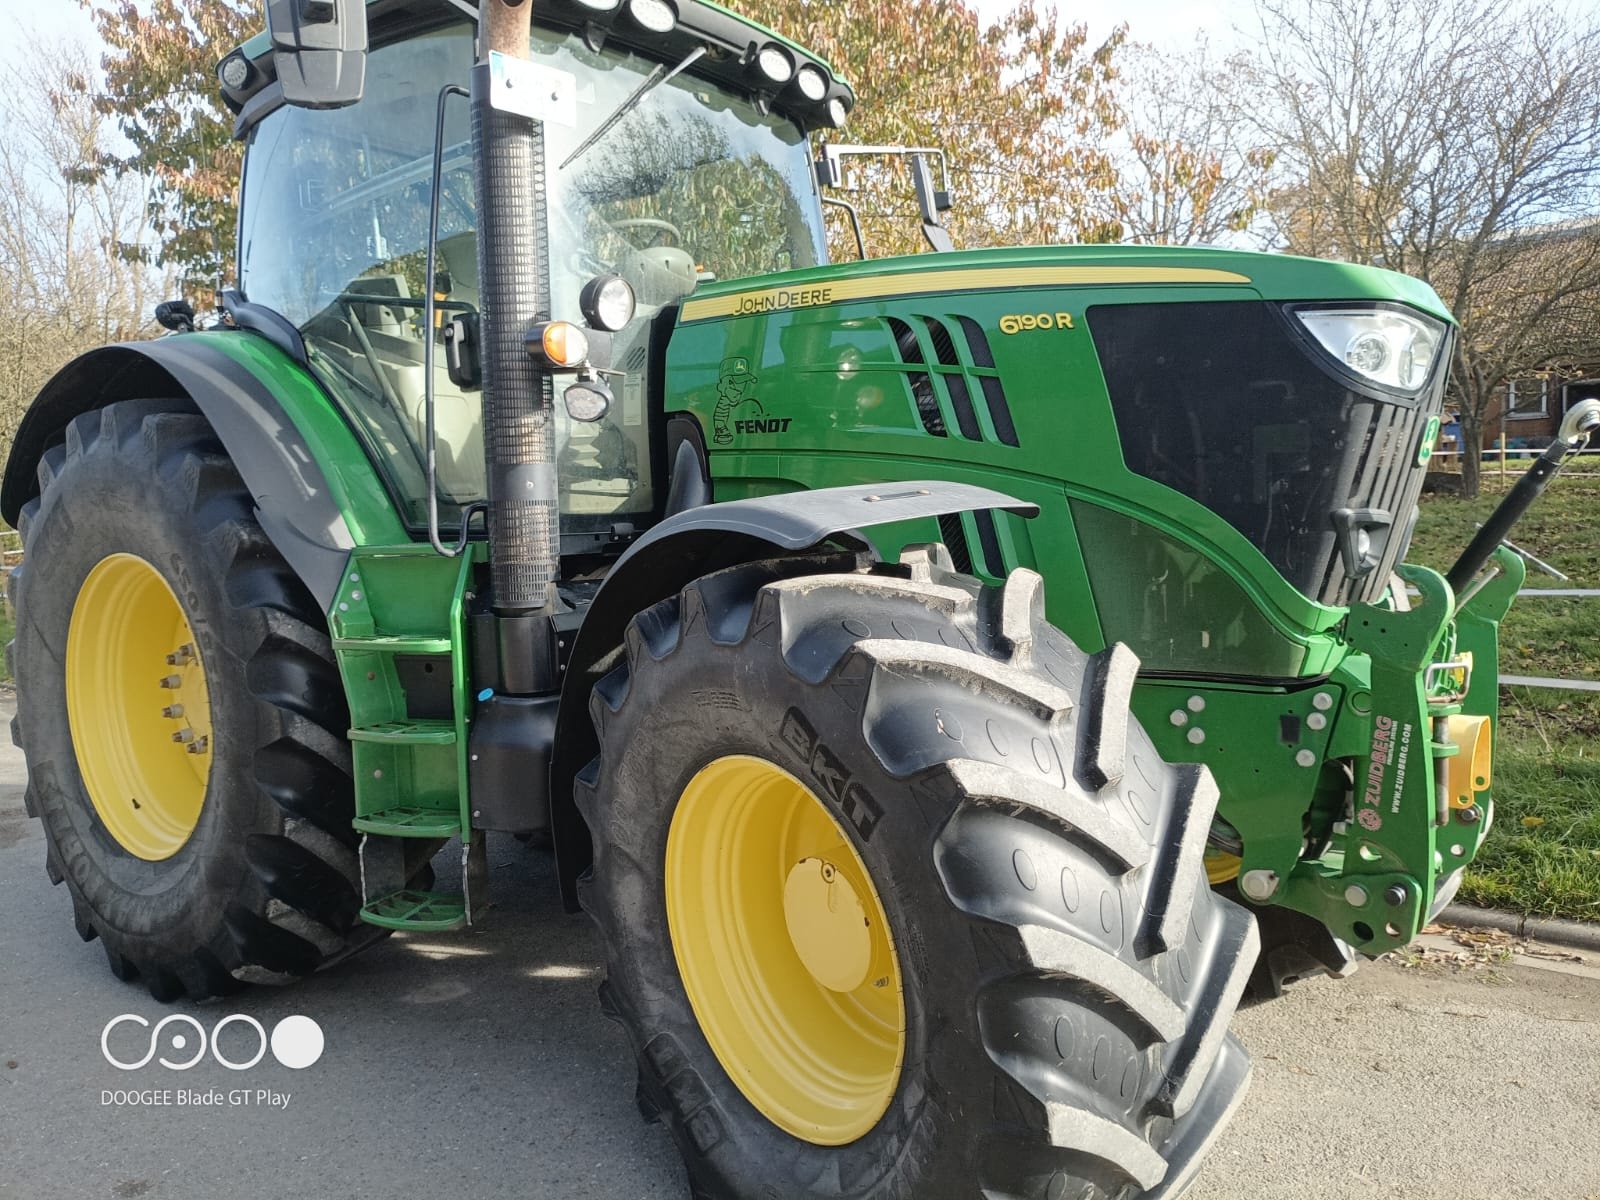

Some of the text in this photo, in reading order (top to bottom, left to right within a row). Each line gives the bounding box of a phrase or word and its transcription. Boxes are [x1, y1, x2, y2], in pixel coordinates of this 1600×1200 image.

[735, 288, 832, 313] JOHN DEERE
[999, 312, 1074, 334] 6190 R
[735, 418, 792, 434] FENDT
[780, 707, 884, 840] BKT
[1364, 715, 1393, 807] ZUIDBERG
[1391, 723, 1413, 814] WWW.ZUIDBERG.COM
